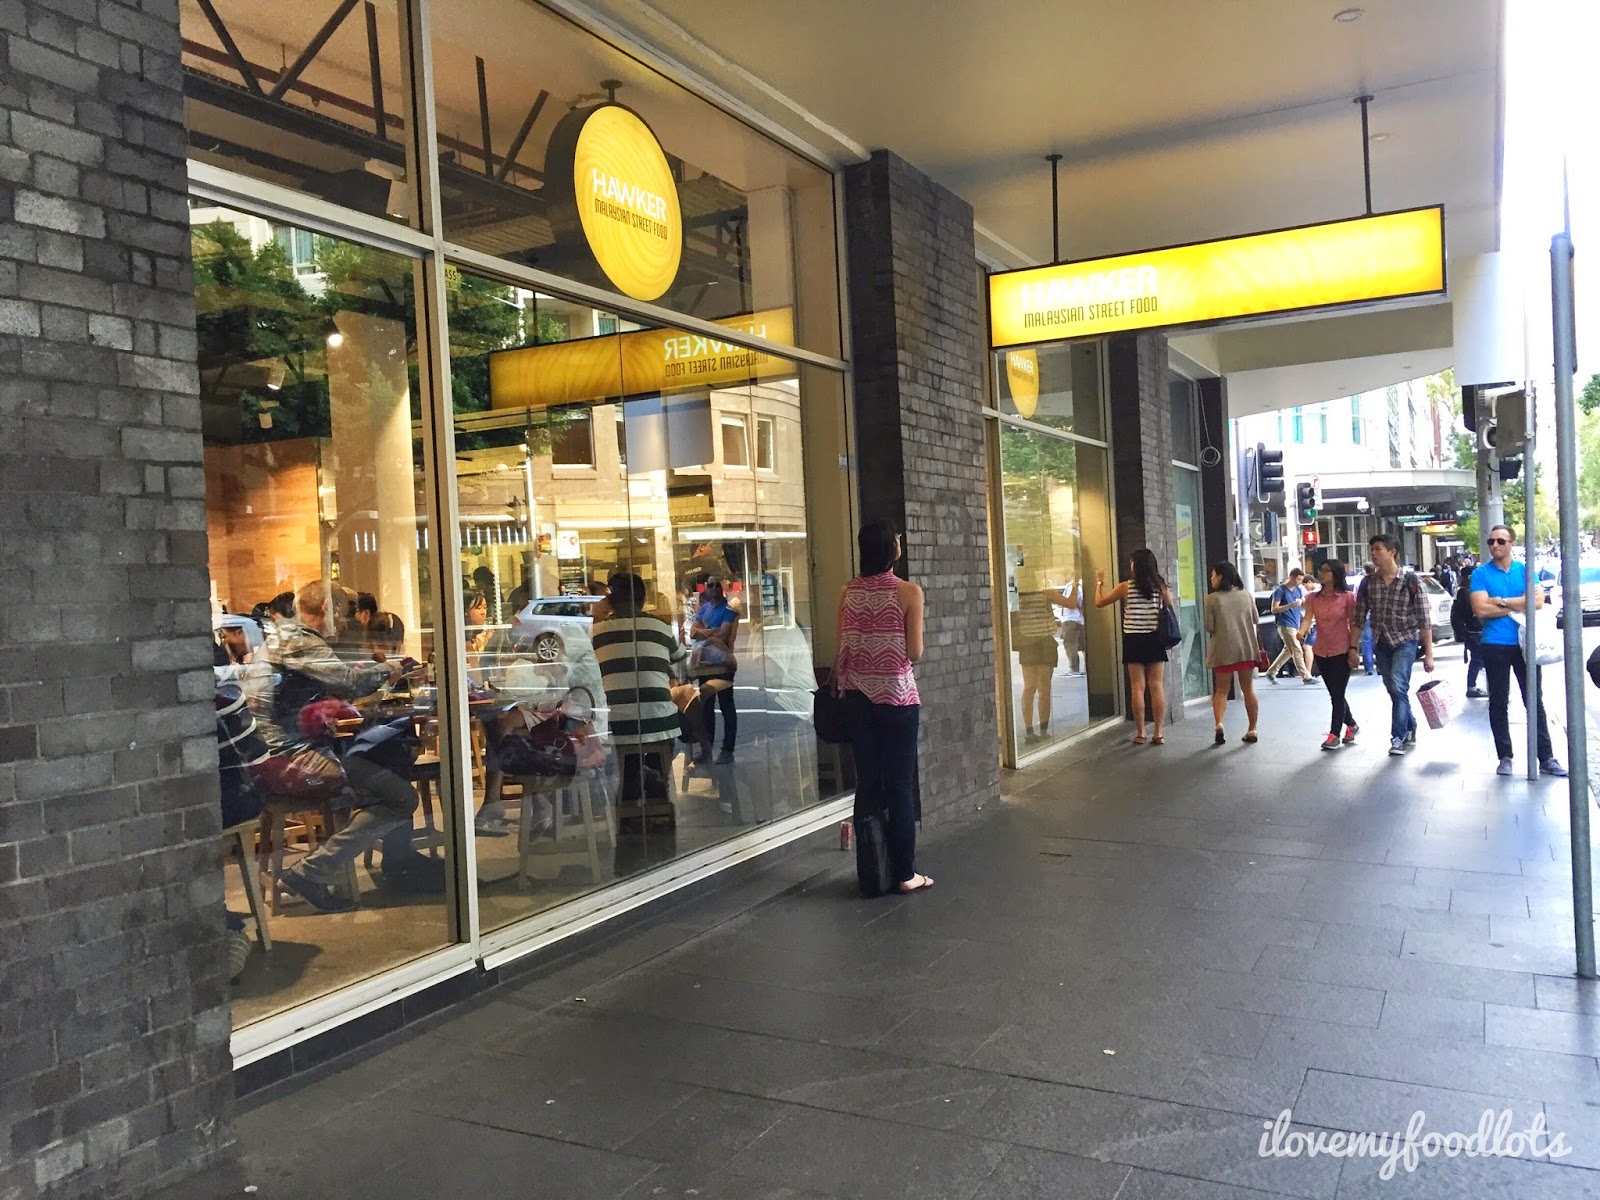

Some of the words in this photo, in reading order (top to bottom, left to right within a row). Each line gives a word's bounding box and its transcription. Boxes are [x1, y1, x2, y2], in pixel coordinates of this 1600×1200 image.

[592, 168, 667, 223] HAWKER
[595, 198, 631, 226] MALAYSIAN
[631, 213, 652, 234] STREET
[653, 222, 668, 240] FOOD
[1021, 264, 1159, 310] HAWKER
[1024, 306, 1084, 329] MALAYSIAN
[1089, 300, 1125, 320] STREET
[1130, 296, 1158, 314] FOOD
